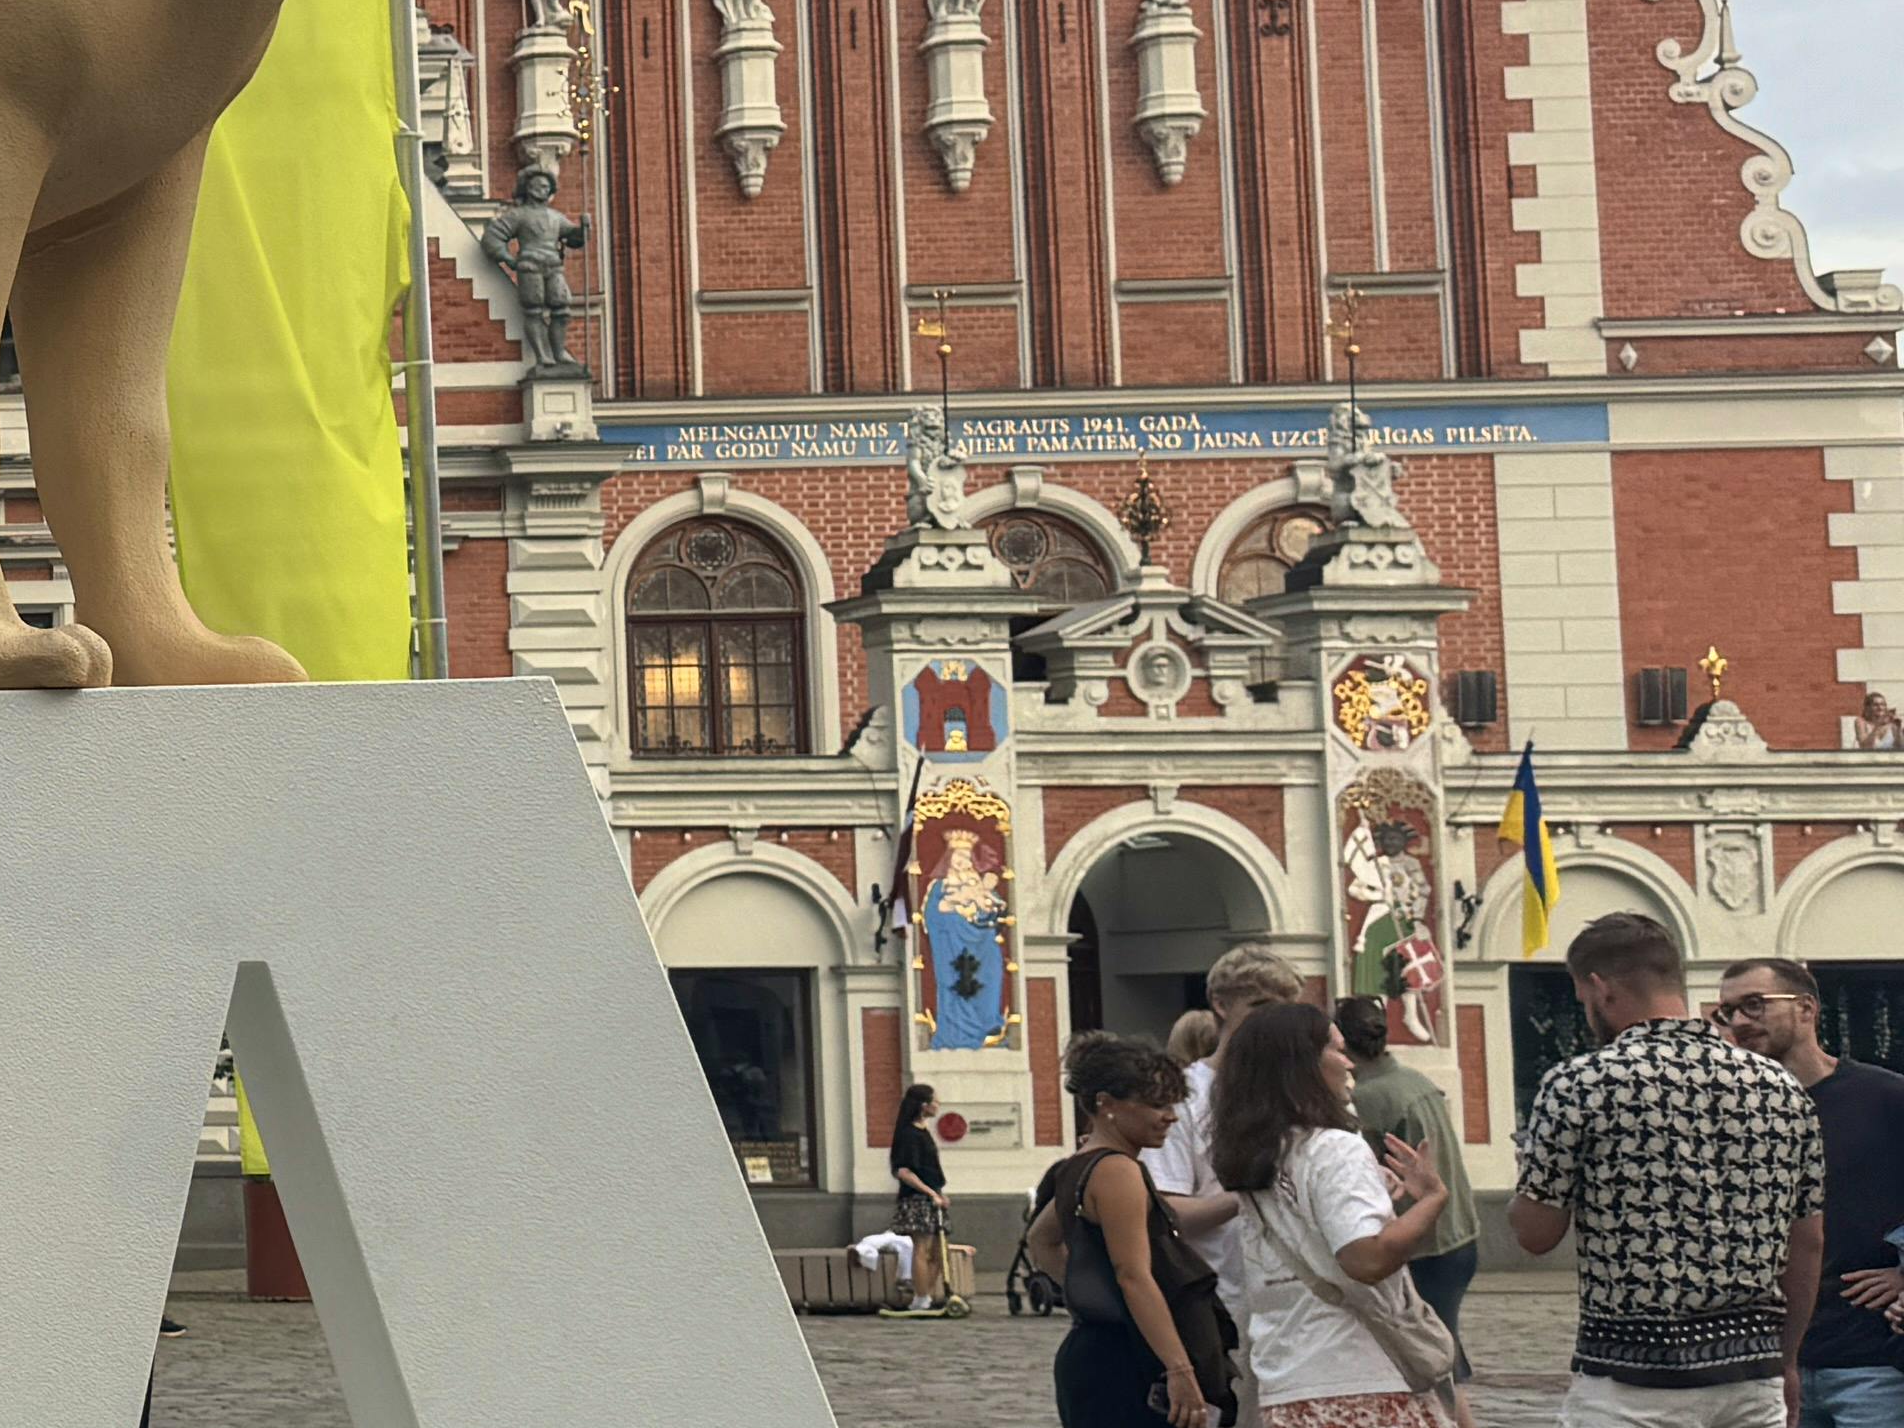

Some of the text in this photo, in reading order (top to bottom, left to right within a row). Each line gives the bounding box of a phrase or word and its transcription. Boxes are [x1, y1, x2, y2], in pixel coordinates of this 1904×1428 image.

[678, 424, 818, 443] MELNGALVJU
[829, 421, 888, 440] NAMS
[962, 418, 1071, 437] SAGRAUTS
[1082, 416, 1129, 434] 1941.
[666, 444, 704, 460] PAR
[715, 442, 780, 459] GODU
[791, 439, 857, 457] NAMU
[869, 438, 900, 455] UZ
[1147, 433, 1182, 450] NO
[1193, 430, 1262, 453] JAUNA
